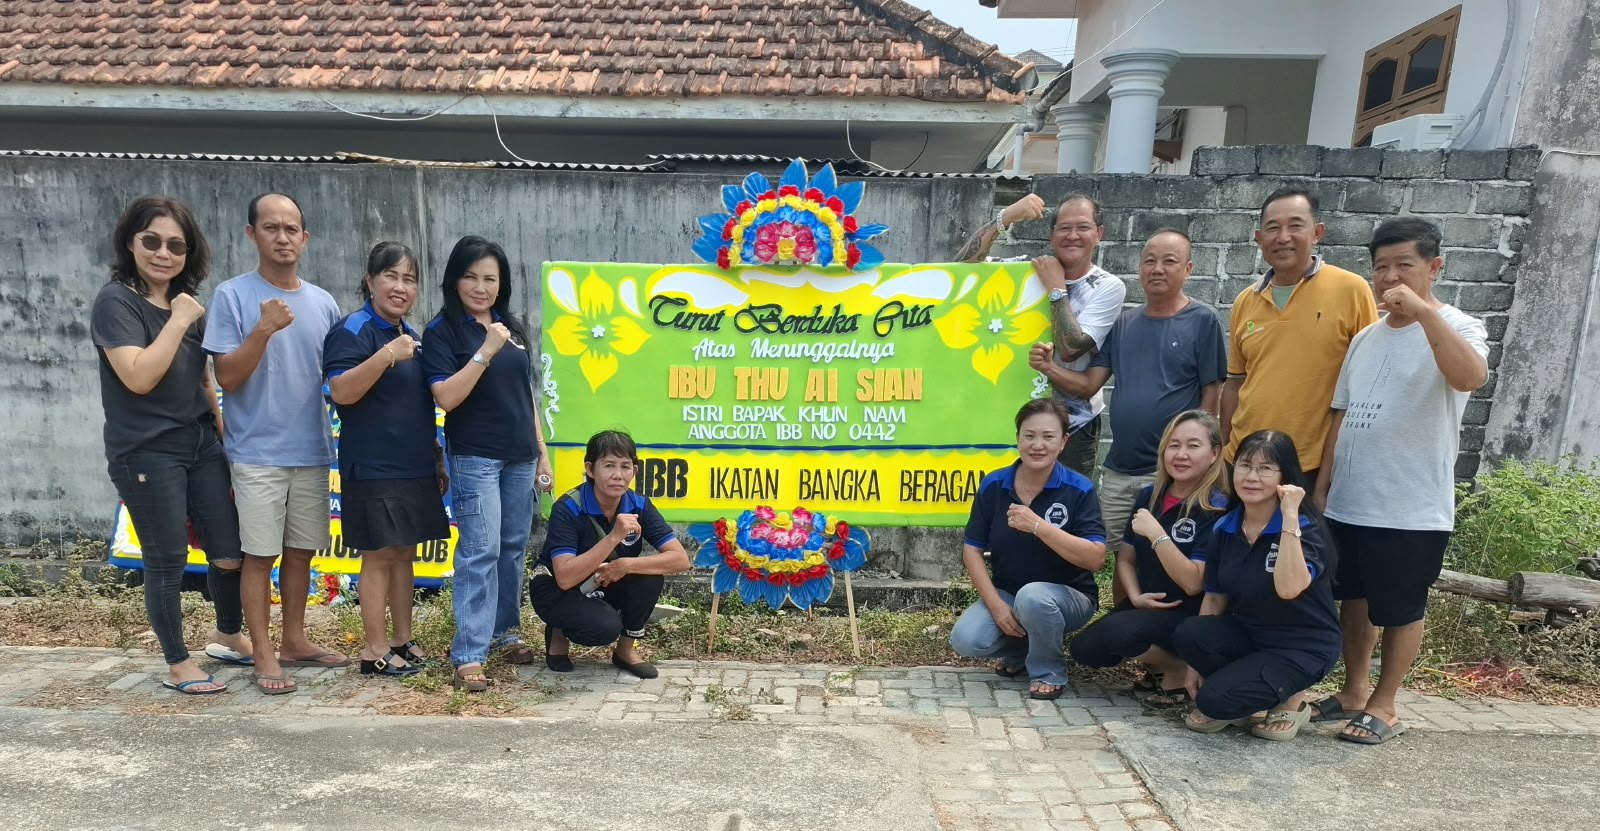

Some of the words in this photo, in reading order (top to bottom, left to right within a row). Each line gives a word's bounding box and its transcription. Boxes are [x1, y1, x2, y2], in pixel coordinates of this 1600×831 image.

[649, 295, 726, 331] Turut
[734, 303, 862, 334] Berduka
[692, 338, 736, 361] Atas
[669, 365, 716, 400] IBU
[734, 367, 789, 401] THU
[805, 368, 838, 402] AI
[856, 368, 923, 402] SIAN
[683, 405, 723, 422] ISTRI
[733, 406, 786, 422] BAPAK
[798, 406, 848, 423] KHUN
[864, 406, 907, 423] NAM
[1350, 401, 1382, 410] HARLEM
[1346, 411, 1378, 420] QUEENS
[688, 424, 767, 440] ANGGOTA
[776, 424, 803, 440] IBB
[811, 424, 837, 440] NO
[848, 424, 897, 441] 0442
[1345, 421, 1371, 430] BRONX
[635, 458, 689, 498] IBB
[710, 467, 779, 500] IKATAN
[799, 468, 881, 501] BANGKA
[900, 469, 986, 502] BERAGA
